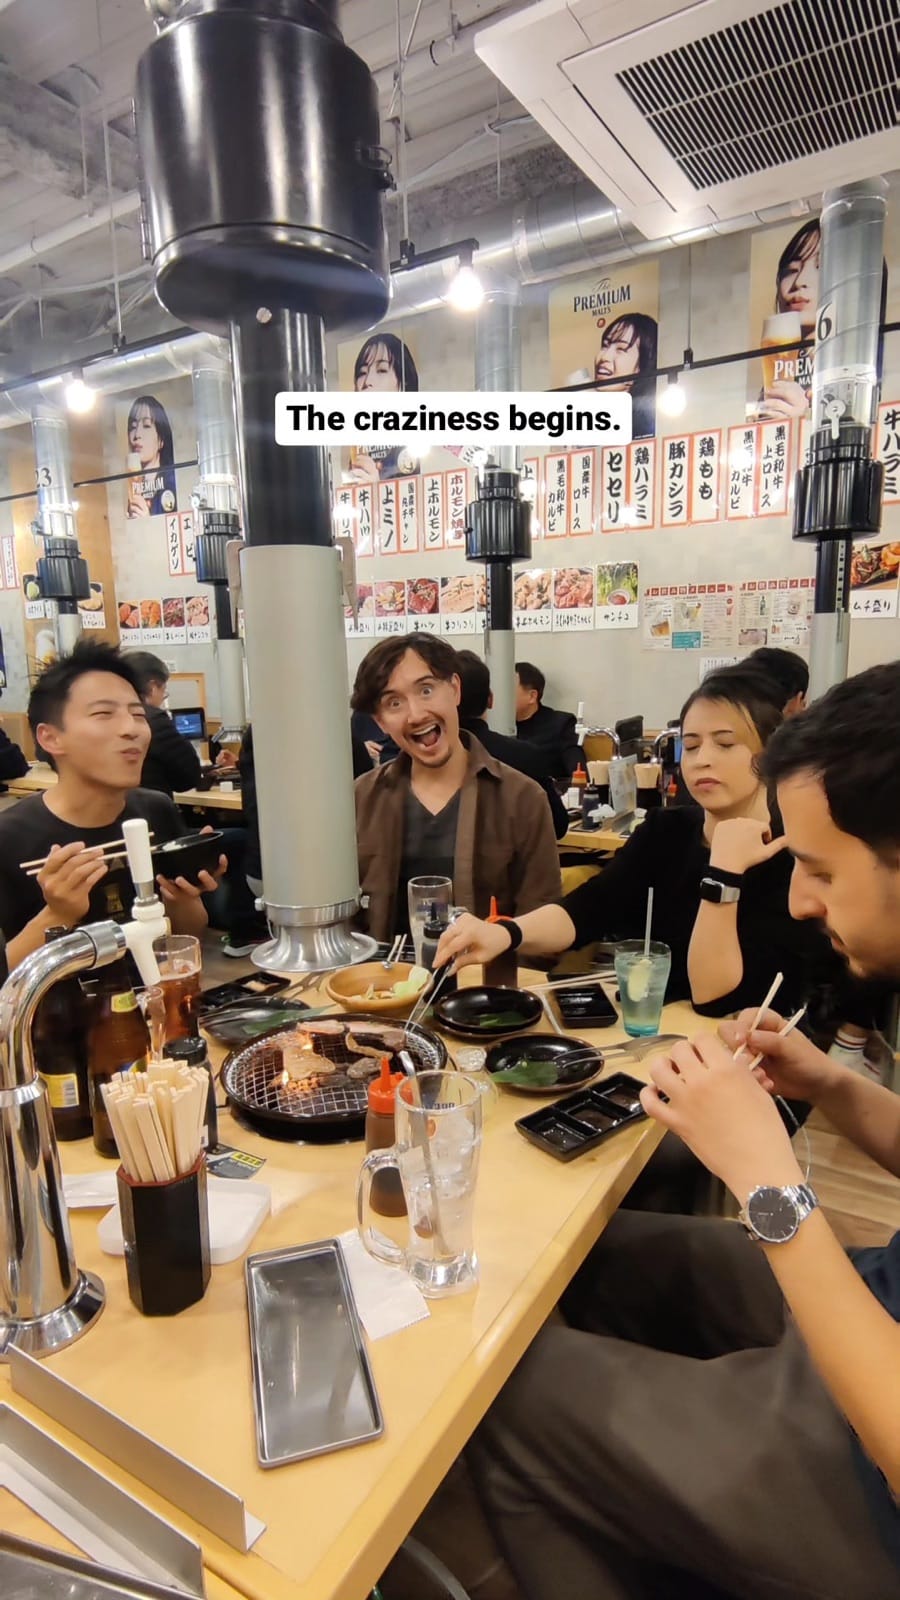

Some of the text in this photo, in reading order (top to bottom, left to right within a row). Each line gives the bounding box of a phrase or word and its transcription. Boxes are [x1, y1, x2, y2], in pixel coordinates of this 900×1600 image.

[574, 284, 631, 312] PREMIUM
[817, 303, 832, 341] 6
[774, 357, 814, 380] PREM
[634, 447, 650, 520] 鶏ハラミ
[668, 440, 686, 518] 豚カシラ
[698, 436, 715, 500] 鶏もも
[742, 430, 754, 487] 黒牛
[761, 445, 773, 508] 上ロース
[773, 425, 785, 489] 黒毛和牛
[132, 477, 165, 496] PREMIUM
[428, 478, 440, 542] 上ホルモン
[547, 492, 556, 532] カルビ
[556, 459, 565, 516] 黒毛和牛
[573, 488, 581, 530] ロース
[606, 451, 623, 523] セセリ
[730, 470, 741, 510] カルビ
[382, 485, 394, 547] 上ミノ
